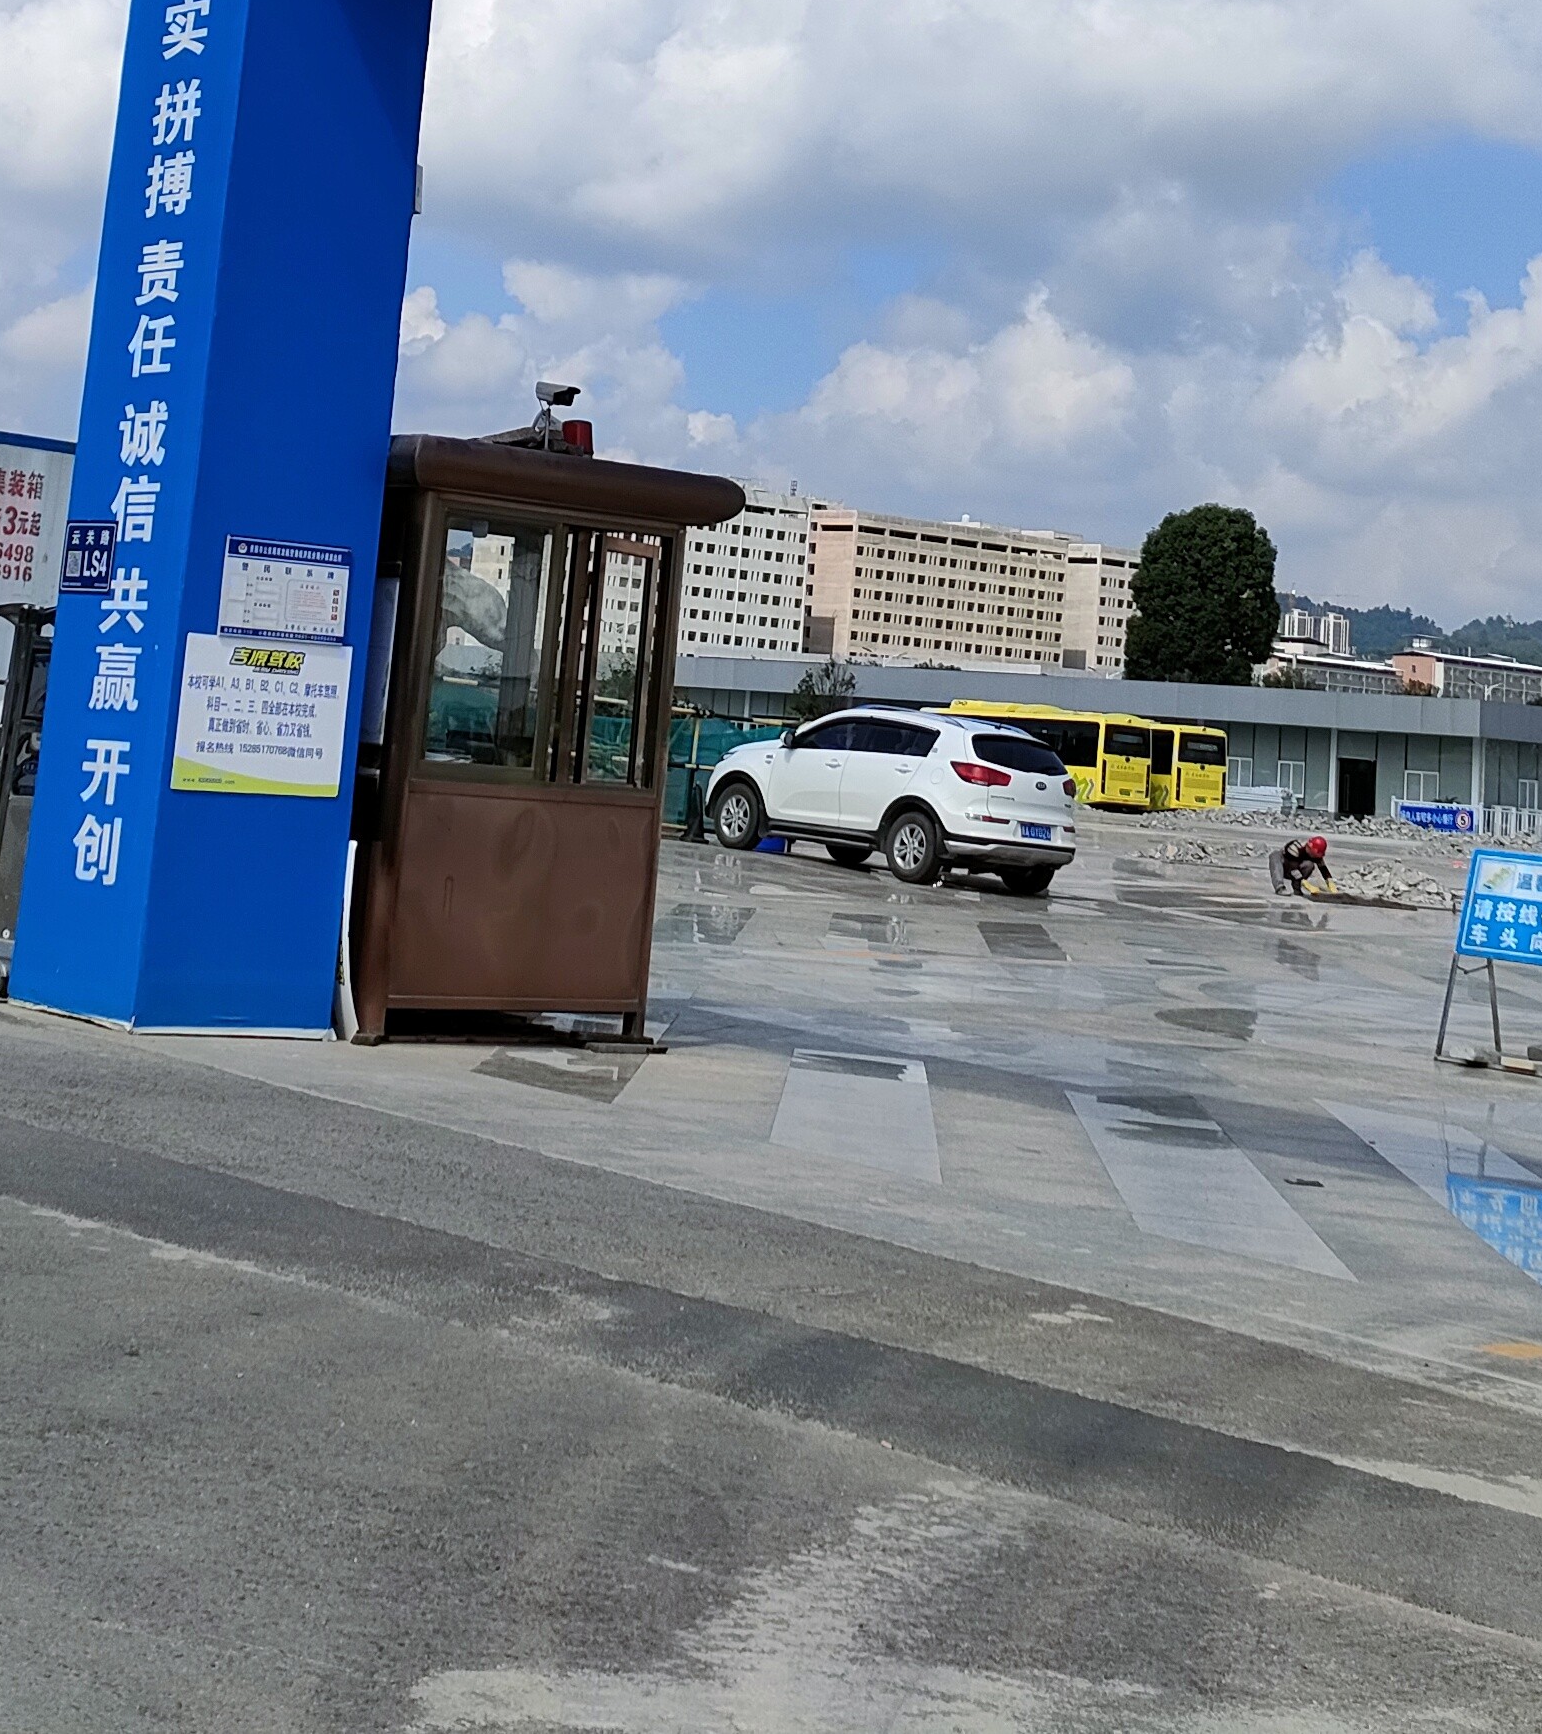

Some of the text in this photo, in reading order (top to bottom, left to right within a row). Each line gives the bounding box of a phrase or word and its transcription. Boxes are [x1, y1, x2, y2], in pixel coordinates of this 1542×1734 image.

[145, 78, 202, 218] 拼搏
[127, 239, 185, 379] 责任
[111, 400, 167, 545] 诚信
[83, 550, 108, 577] LS4
[90, 565, 150, 715] 共赢
[72, 737, 131, 888] 开创
